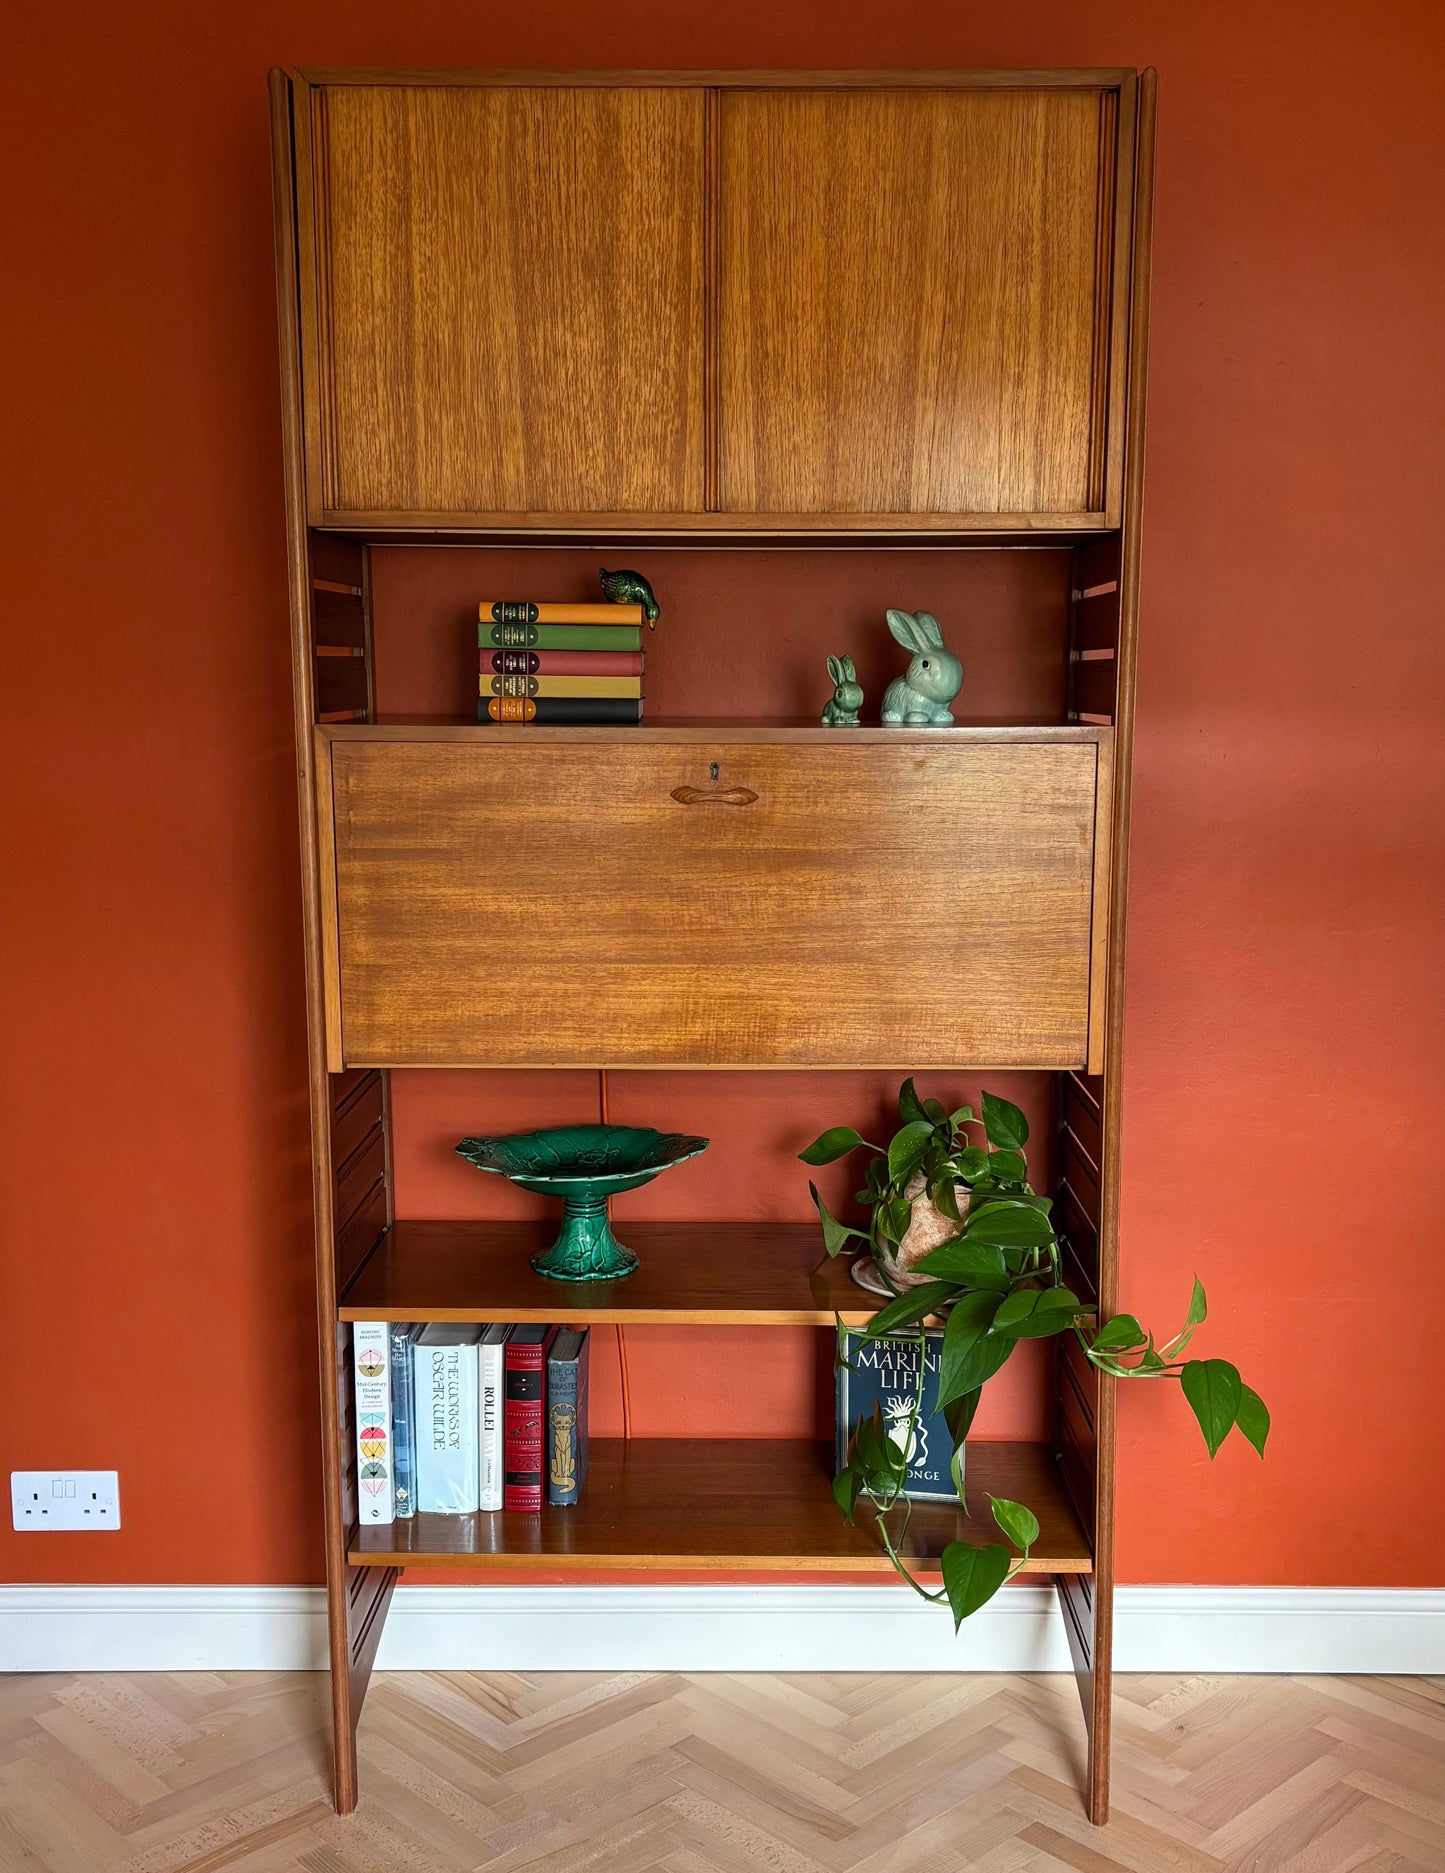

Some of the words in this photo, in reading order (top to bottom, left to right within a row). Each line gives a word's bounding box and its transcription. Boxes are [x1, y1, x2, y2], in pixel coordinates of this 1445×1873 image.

[432, 1351, 445, 1401] OSCAR
[448, 1351, 459, 1379] THE
[550, 1368, 564, 1376] THE
[433, 1403, 446, 1450] WILDE
[448, 1381, 460, 1430] WORKS
[484, 1386, 495, 1431] ROLLEI
[448, 1431, 460, 1450] OF
